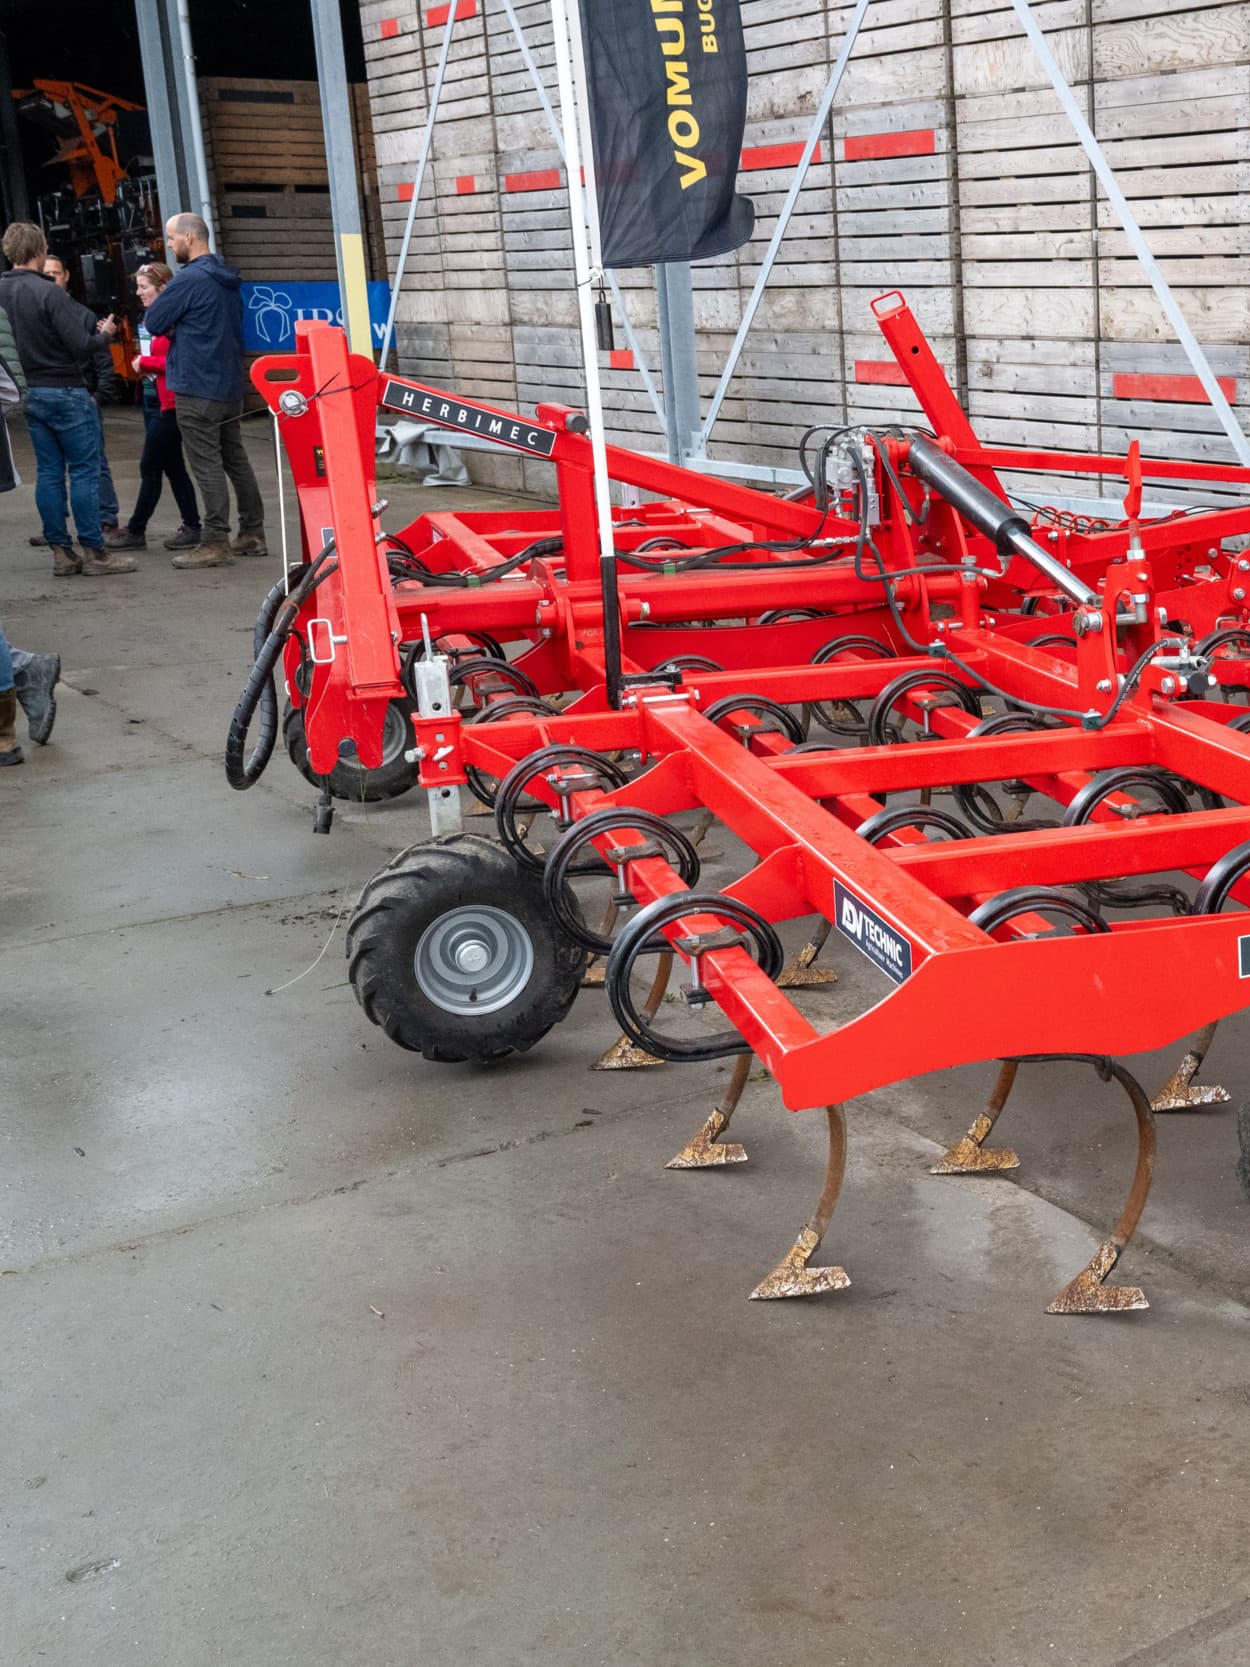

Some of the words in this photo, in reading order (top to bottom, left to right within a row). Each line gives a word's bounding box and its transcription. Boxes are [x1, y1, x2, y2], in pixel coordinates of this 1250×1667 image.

[651, 0, 707, 190] VOMU
[402, 391, 538, 445] HERBIMEC
[863, 914, 903, 968] TECHNIC
